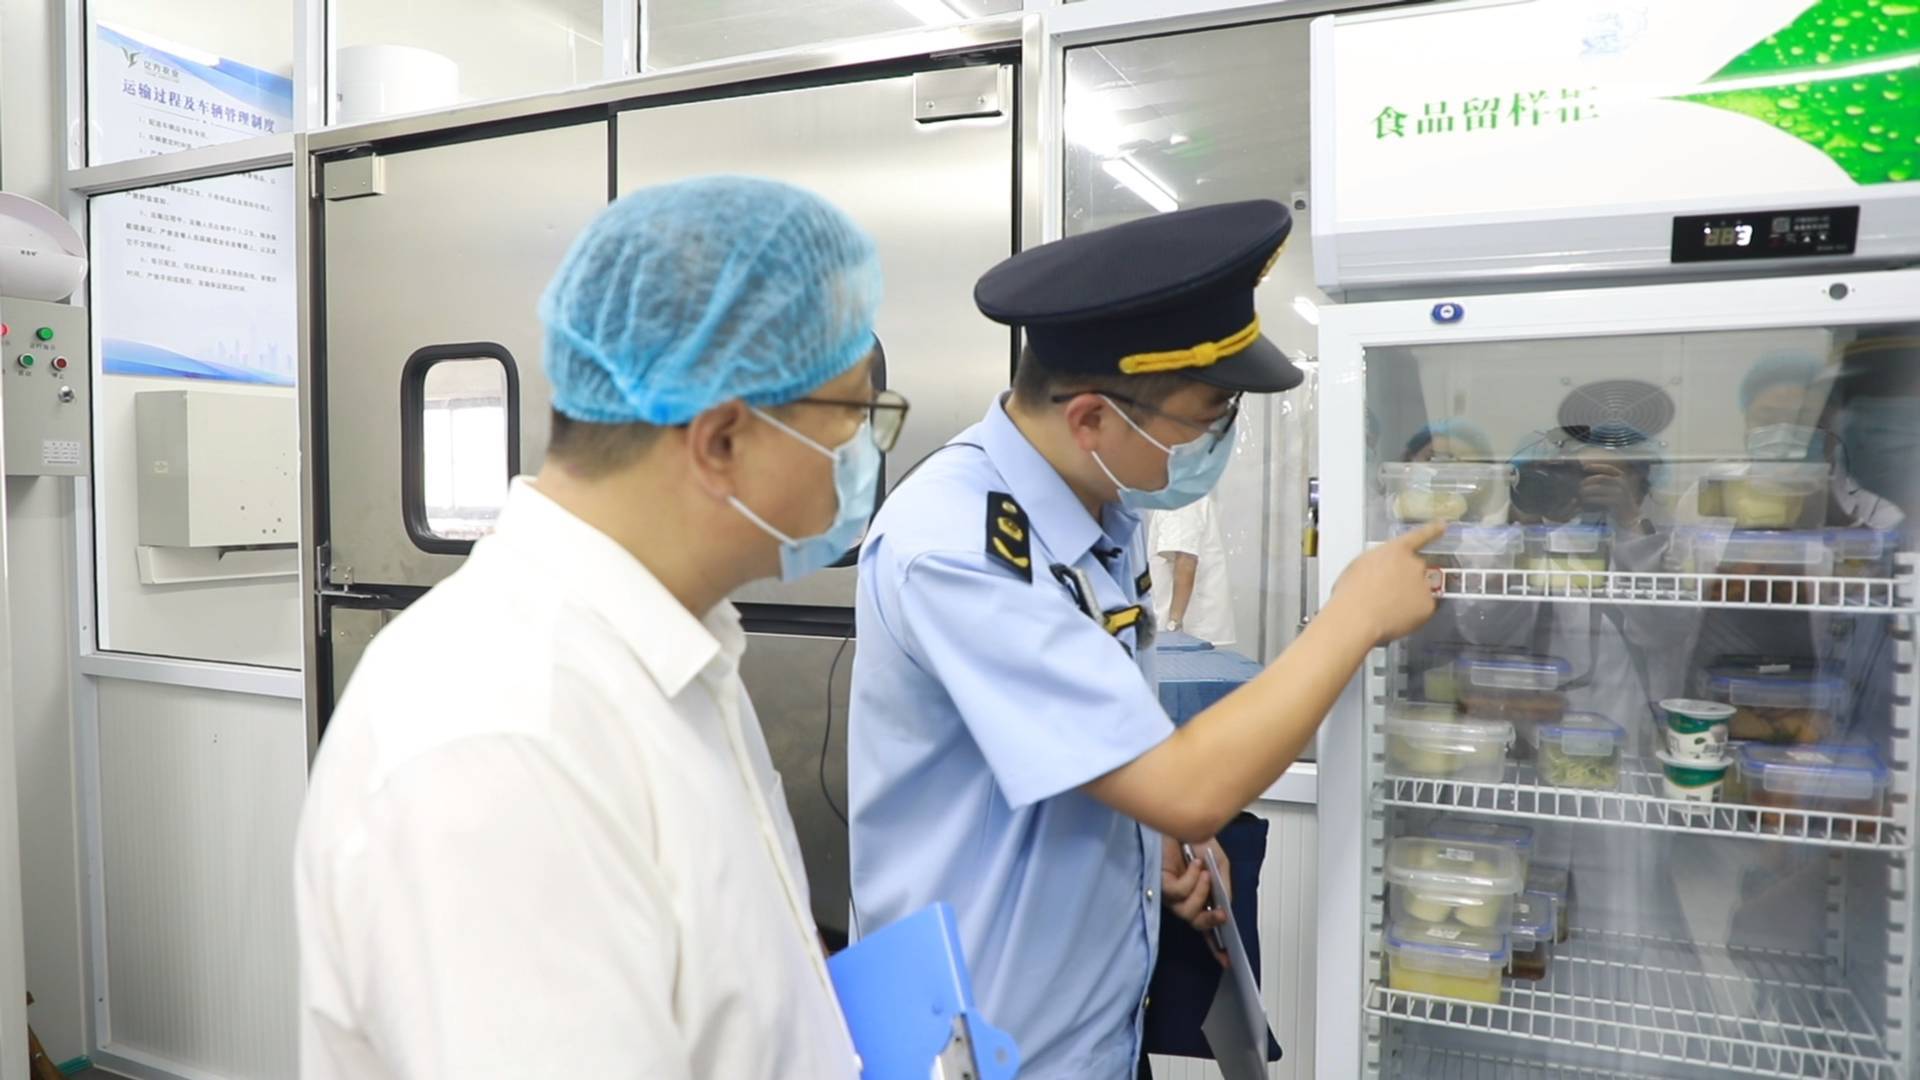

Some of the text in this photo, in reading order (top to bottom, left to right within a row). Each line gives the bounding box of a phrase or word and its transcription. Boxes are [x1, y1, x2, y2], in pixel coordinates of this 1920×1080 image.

[122, 78, 276, 134] 运输过程及车辆管理制度
